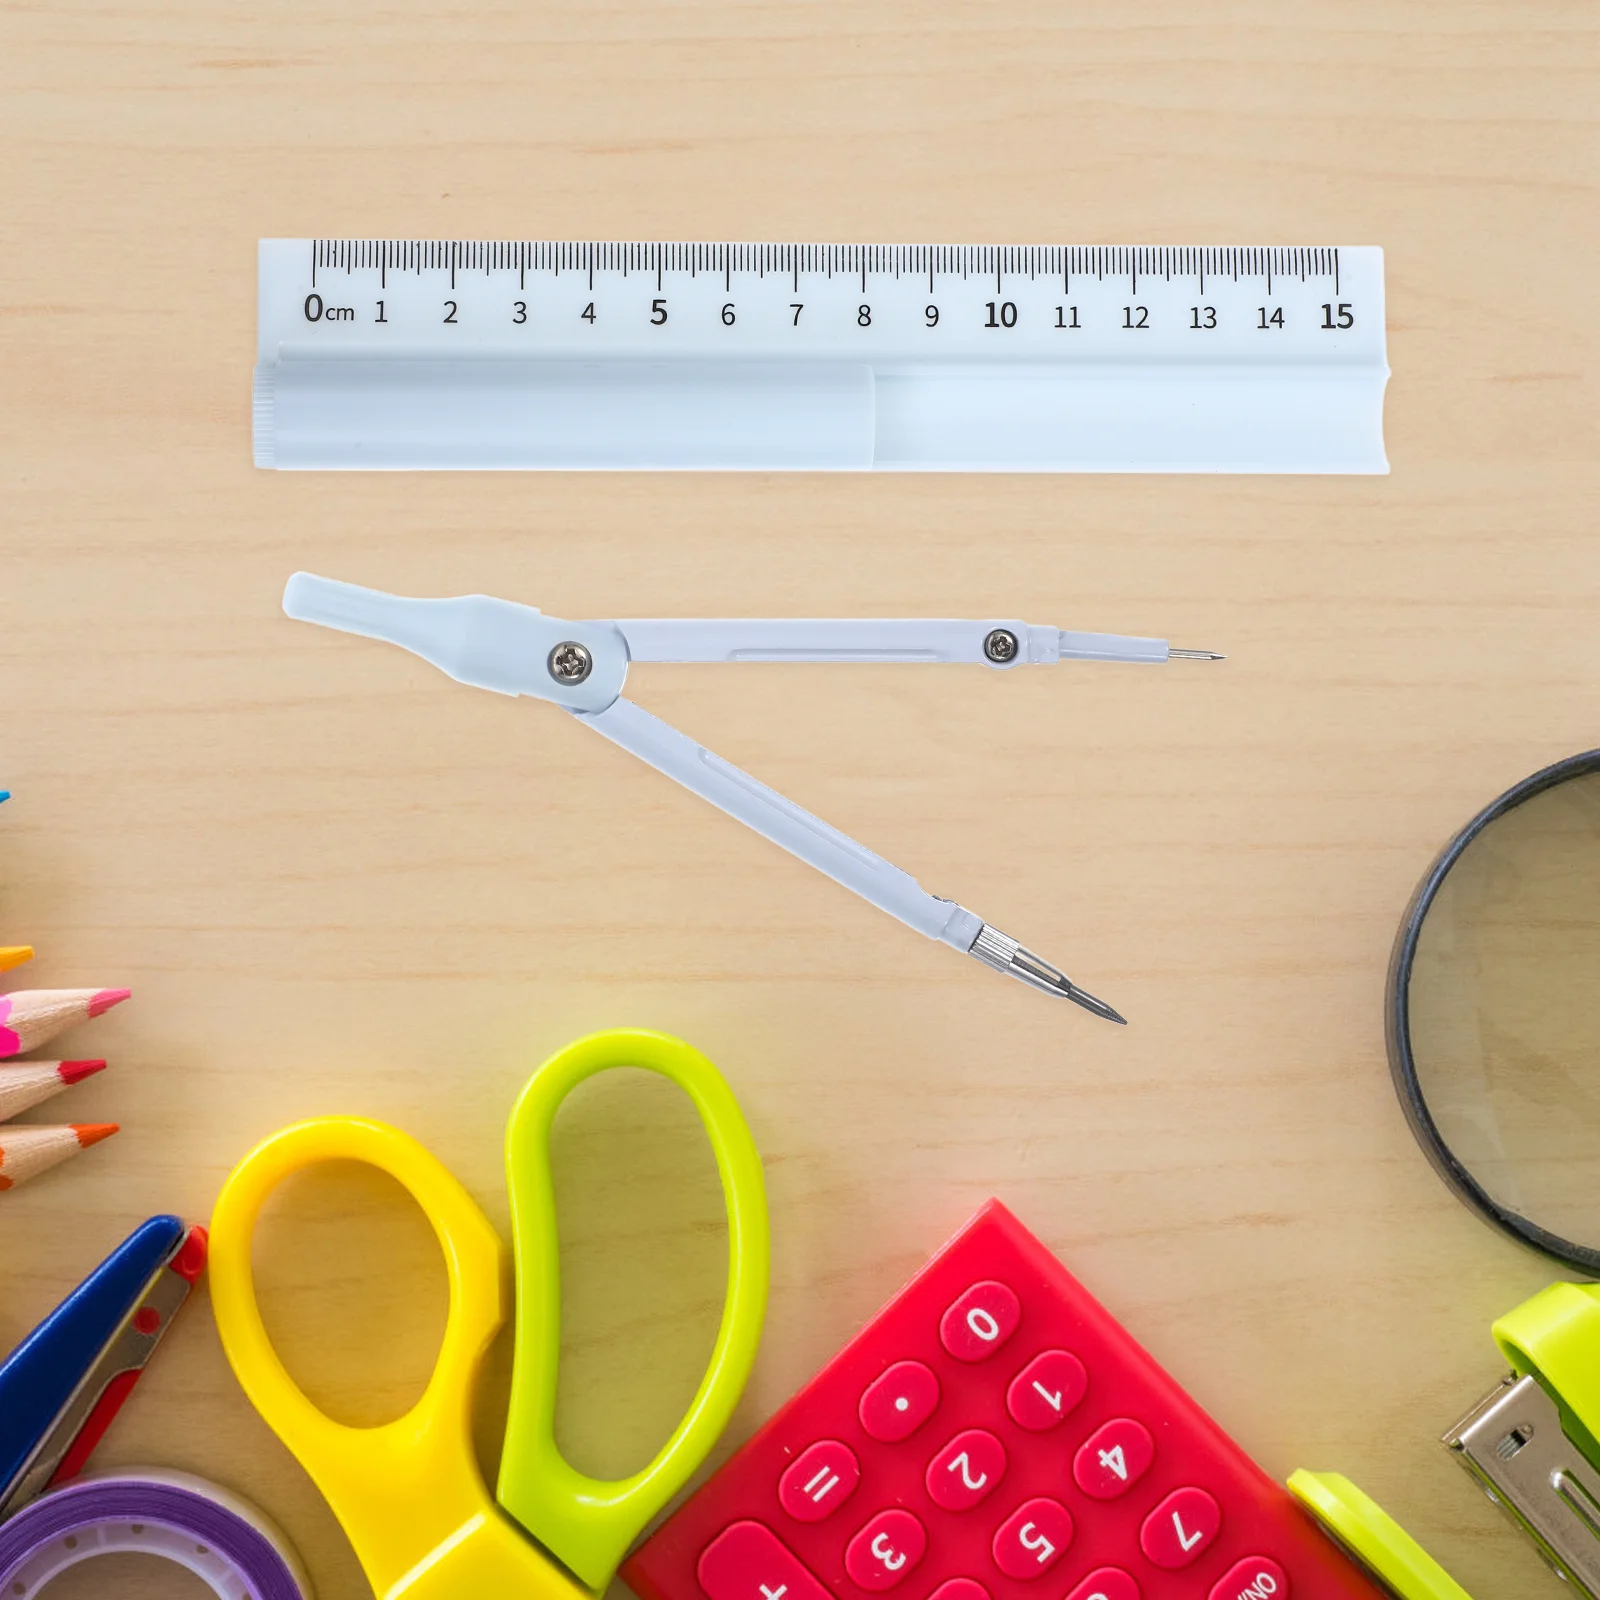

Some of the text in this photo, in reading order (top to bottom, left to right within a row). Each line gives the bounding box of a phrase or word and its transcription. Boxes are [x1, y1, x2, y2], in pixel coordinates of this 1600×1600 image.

[374, 300, 388, 323] 1
[443, 301, 458, 324] 2
[512, 301, 527, 325] 3
[580, 302, 597, 325] 4
[649, 298, 668, 326] 5
[721, 302, 736, 326] 6
[789, 303, 804, 327] 7
[857, 304, 872, 327] 8
[925, 304, 940, 328] 9
[984, 301, 1018, 328] 10
[1054, 306, 1082, 329] 11
[1122, 306, 1150, 329] 12
[1189, 306, 1217, 329] 13
[1257, 306, 1286, 329] 14
[1320, 303, 1354, 330] 15
[966, 1307, 999, 1341] 0
[1032, 1381, 1062, 1411] 1
[947, 1451, 987, 1490] 2
[1097, 1444, 1128, 1481] 4
[1019, 1522, 1055, 1563] 5
[1172, 1511, 1203, 1552] 7
[871, 1532, 907, 1571] 3
